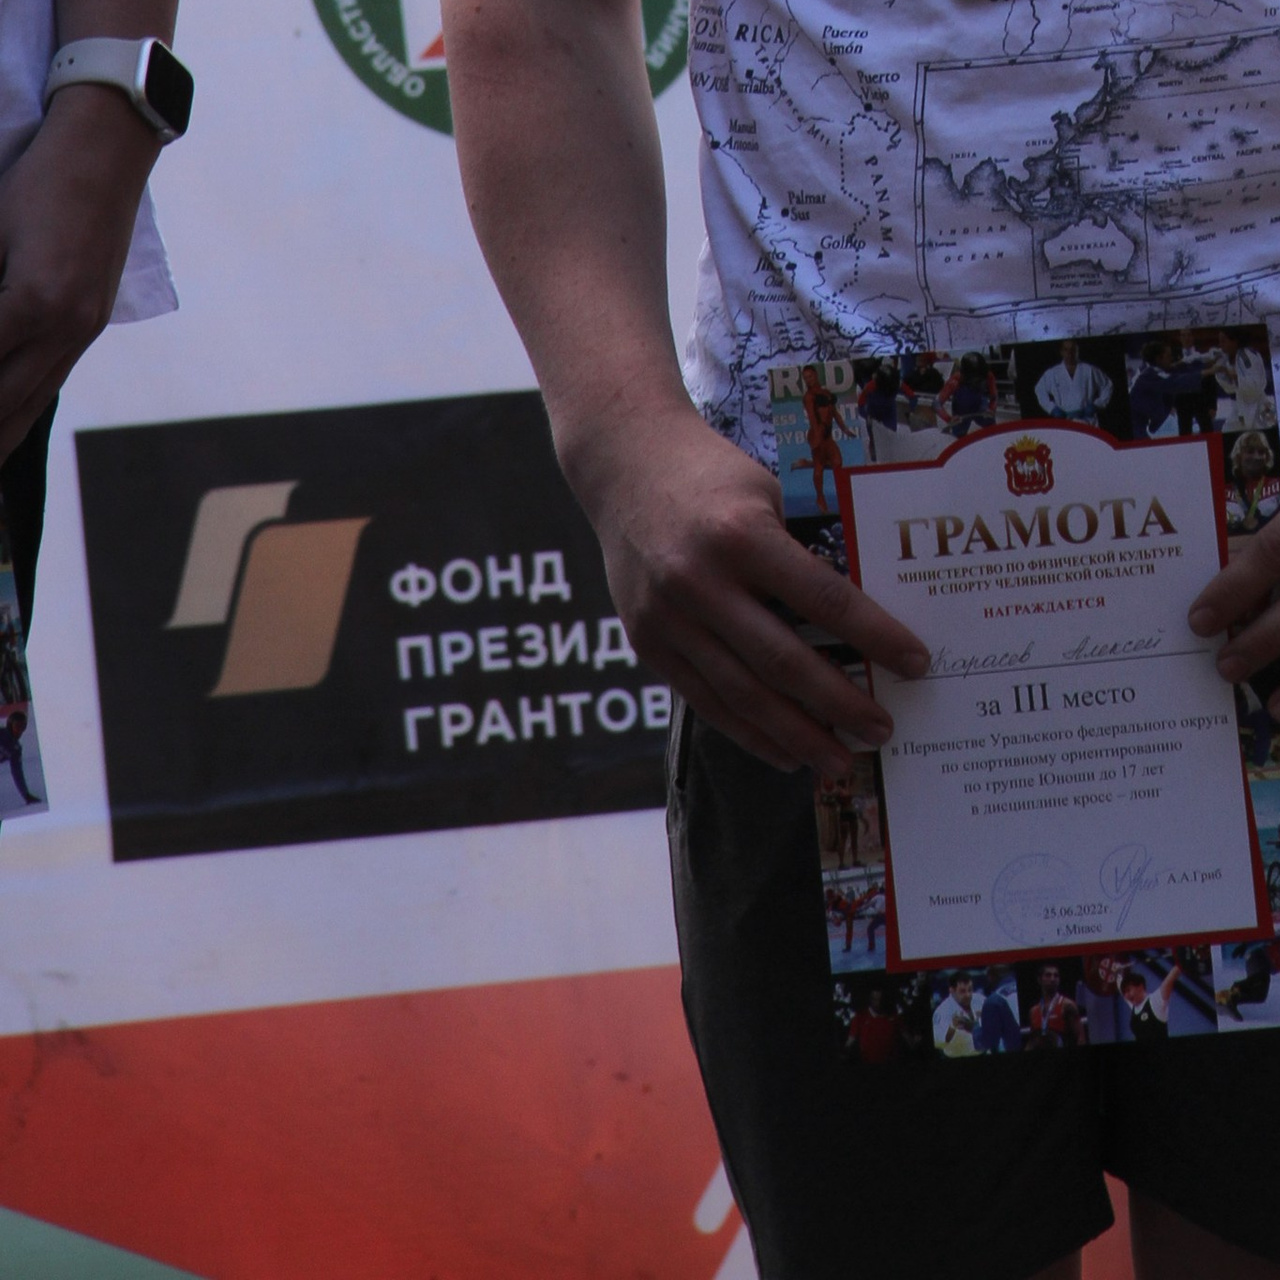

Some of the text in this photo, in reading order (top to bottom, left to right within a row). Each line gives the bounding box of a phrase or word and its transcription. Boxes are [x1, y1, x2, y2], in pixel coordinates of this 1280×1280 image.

[734, 22, 786, 43] RICA
[822, 26, 869, 40] Puerto
[857, 69, 901, 85] Puerto
[787, 189, 827, 206] Palmar
[790, 207, 811, 222] Sur
[864, 154, 894, 260] PANAMA
[894, 495, 1178, 561] ГРАМОТА
[390, 551, 571, 608] ФОНД
[897, 545, 1184, 584] МИНИСТЕРСТВО ПО ФИЗИЧЕСКОЙ КУЛЬТУРЕ
[928, 563, 1156, 597] И СПОРТУ ЧЕЛЯБИНСКОЙ ОБЛАСТИ
[983, 596, 1106, 619] НАГРАЖДАЕТСЯ
[396, 618, 640, 682] ПРЕЗИД
[975, 681, 1137, 718] за III место
[403, 686, 673, 753] ГРАНТОВ
[891, 713, 1230, 758] в Первенстве Уральского федерального округа
[941, 740, 1184, 776] по спортивному ориентированию
[963, 762, 1166, 797] по группе Юноши до 17 лет
[970, 804, 980, 816] в
[982, 795, 1069, 817] дисциплине
[1072, 790, 1114, 808] кросс
[1129, 787, 1162, 802] лонг
[929, 892, 982, 908] Министр
[1056, 923, 1103, 937] г.Миасс
